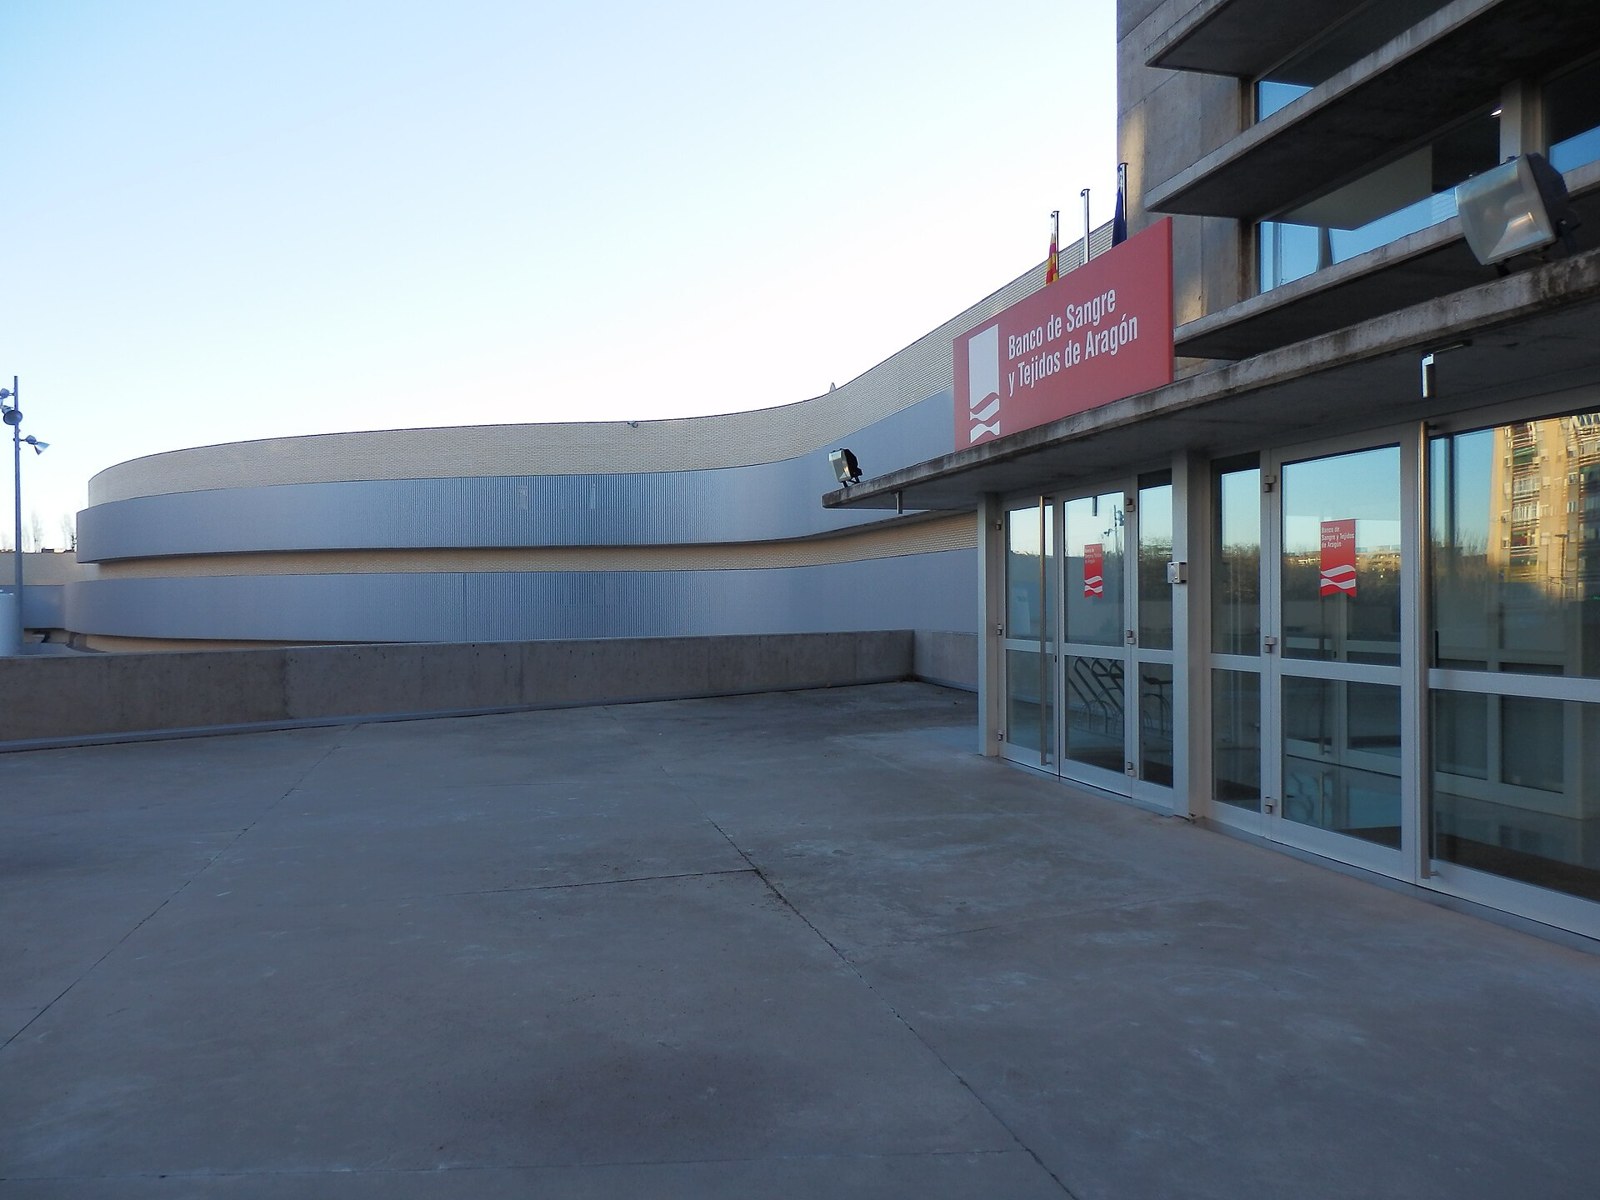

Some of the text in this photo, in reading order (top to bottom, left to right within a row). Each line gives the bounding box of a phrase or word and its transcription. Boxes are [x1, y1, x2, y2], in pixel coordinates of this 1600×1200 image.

[1008, 289, 1116, 360] Banco de Sangre
[1008, 313, 1138, 397] y Tejidos de Aragón
